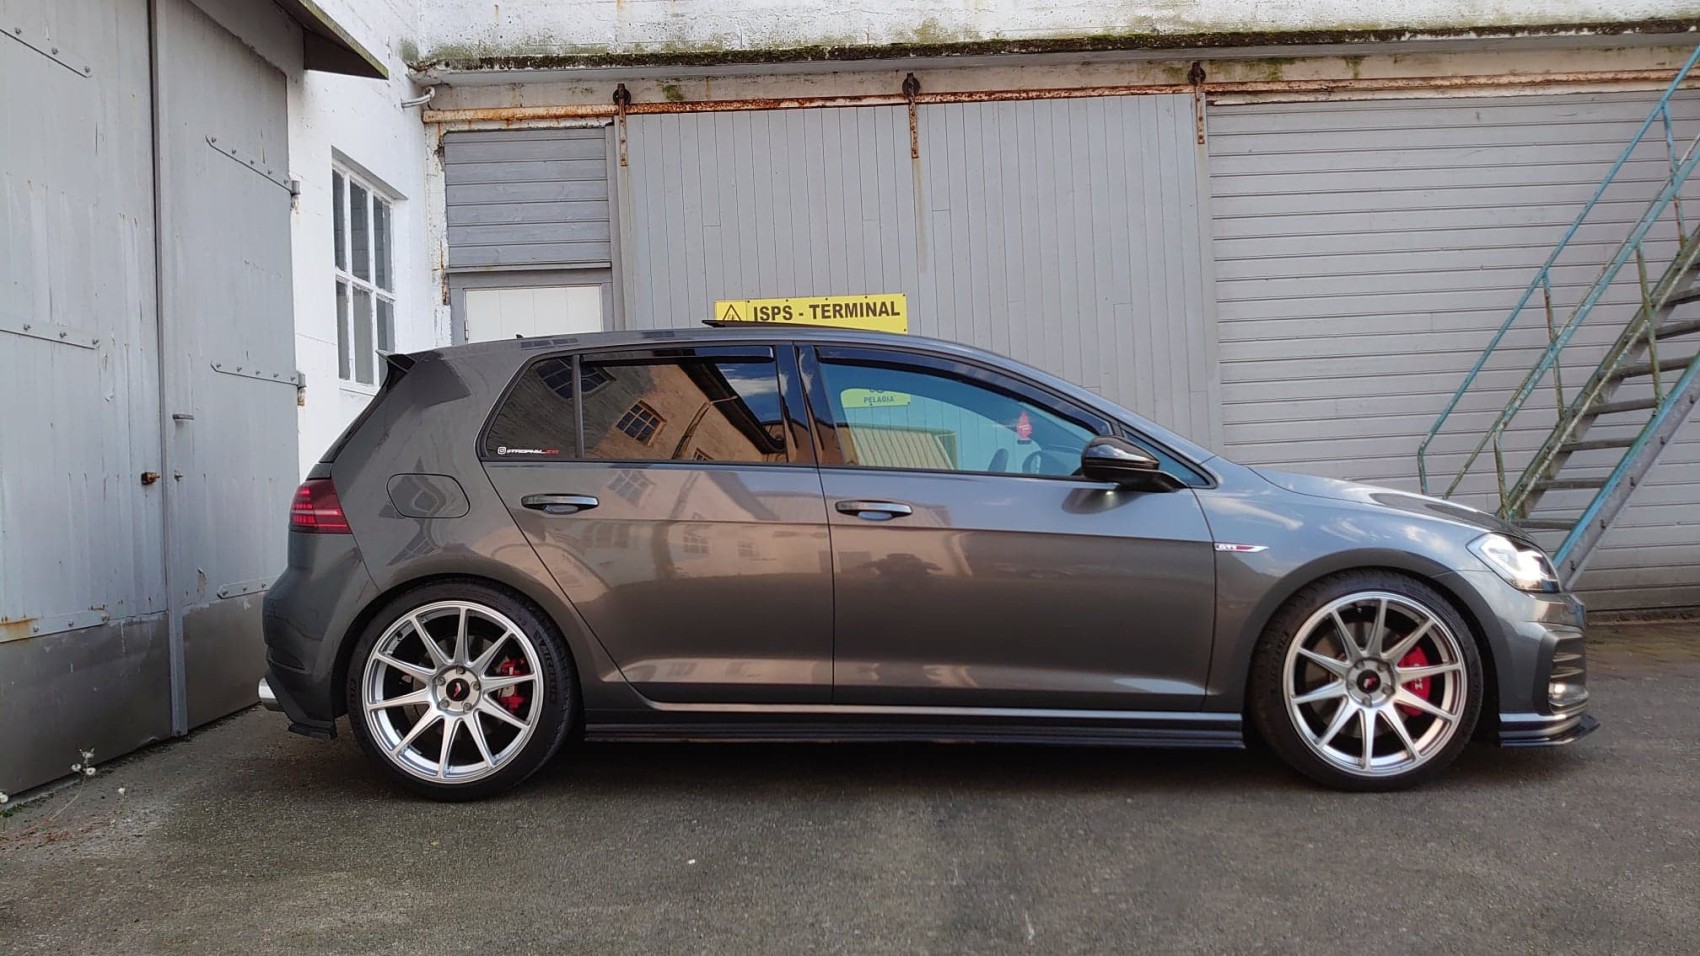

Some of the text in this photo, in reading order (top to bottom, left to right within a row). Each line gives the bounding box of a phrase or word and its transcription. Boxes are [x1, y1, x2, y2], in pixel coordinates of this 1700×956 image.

[753, 305, 793, 321] ISPS
[809, 301, 901, 320] TERMINAL
[863, 395, 895, 404] PELAGIA
